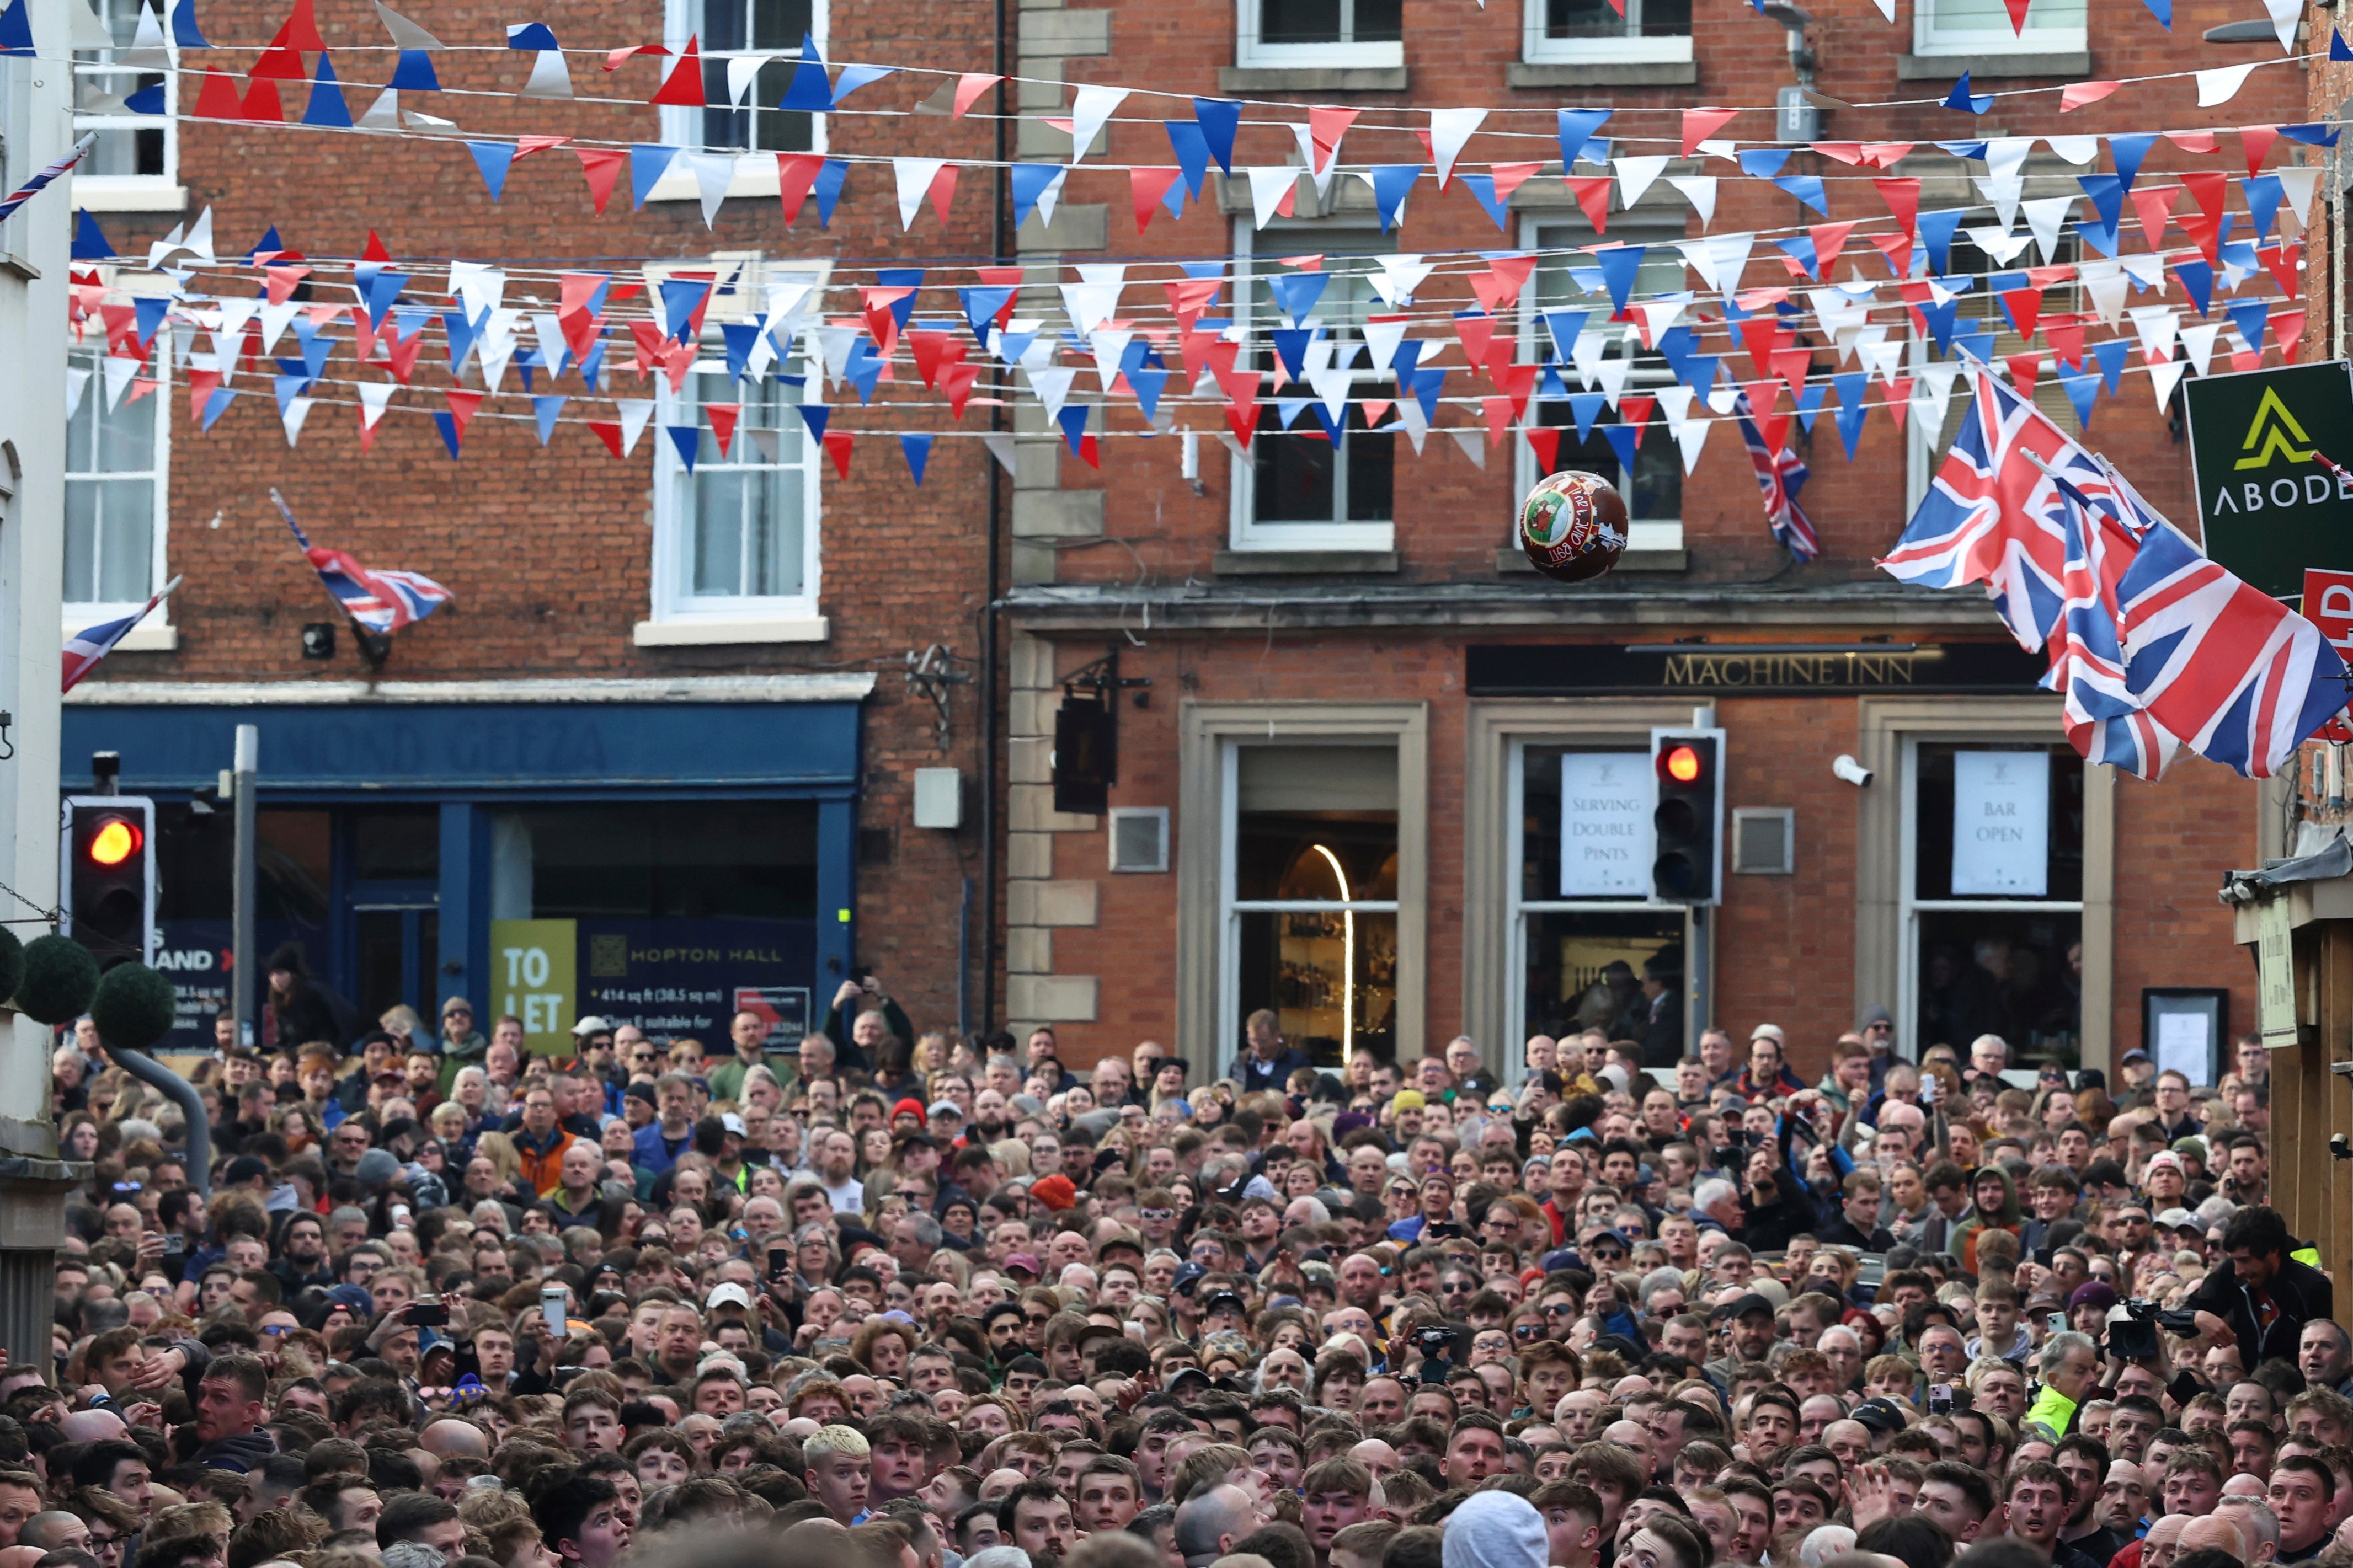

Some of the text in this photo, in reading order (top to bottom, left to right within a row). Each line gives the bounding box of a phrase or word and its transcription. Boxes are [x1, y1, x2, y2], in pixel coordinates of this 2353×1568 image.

[1663, 654, 1913, 686] MACHINE INN
[1573, 798, 1640, 811] SERVING
[1984, 802, 2016, 816] BAR
[1572, 822, 1635, 836] DOUBLE
[1976, 827, 2023, 842] OPEN
[1584, 846, 1628, 860] PINTS
[631, 948, 782, 963] HOPTON HALL
[503, 947, 549, 988] TO
